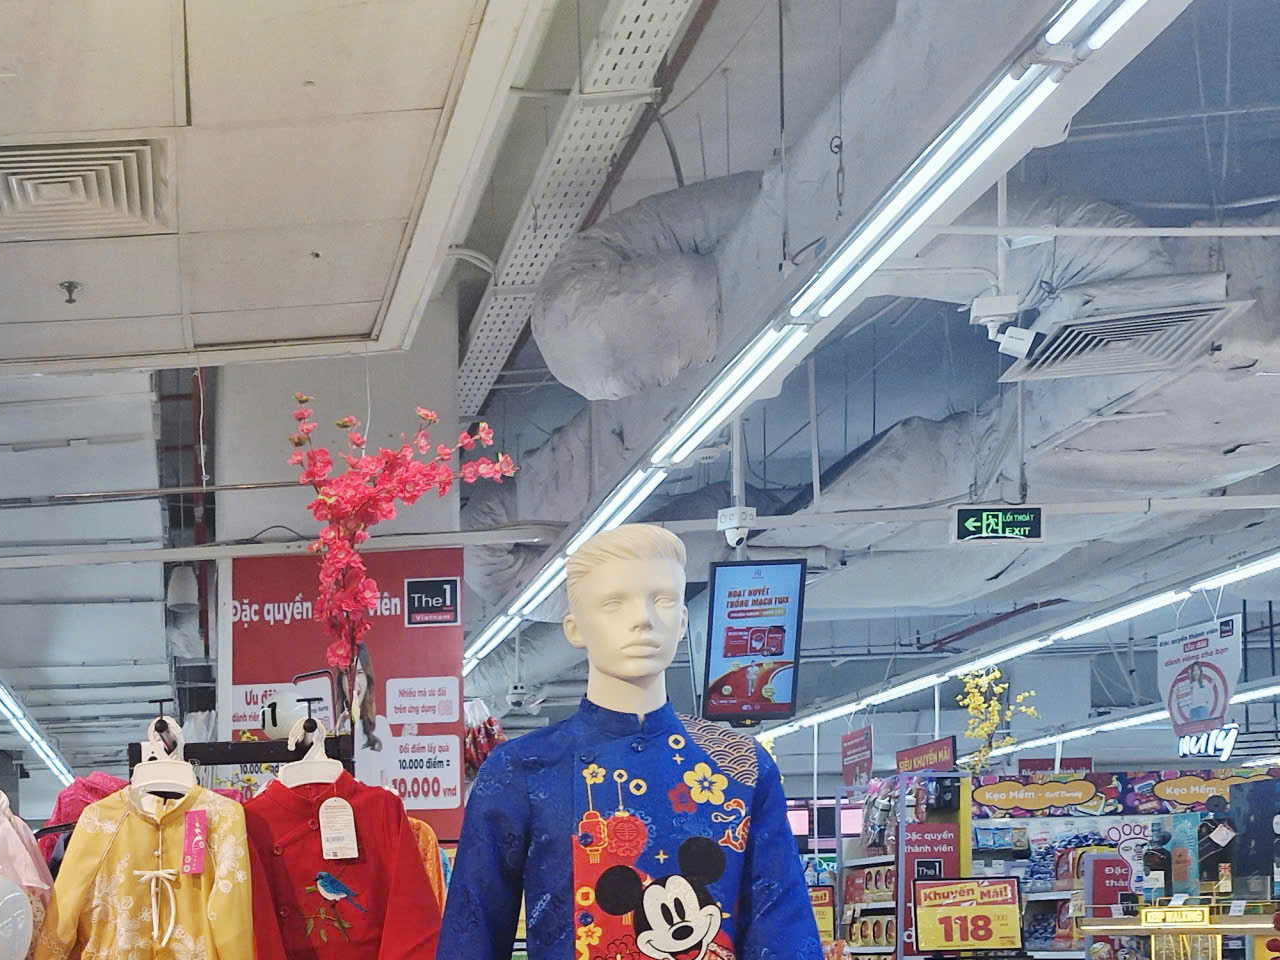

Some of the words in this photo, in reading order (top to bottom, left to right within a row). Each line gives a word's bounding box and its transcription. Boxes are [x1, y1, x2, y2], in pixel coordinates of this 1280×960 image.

[1006, 527, 1031, 535] EXIT
[232, 599, 260, 628] Đặc
[263, 593, 313, 625] quyền
[245, 689, 259, 706] Ưu
[248, 712, 260, 723] riên
[398, 758, 424, 770] 10.000
[425, 756, 444, 769] điểm
[392, 776, 440, 798] 10.000
[924, 830, 954, 841] quyền
[933, 843, 954, 852] viên
[923, 884, 975, 902] Khuyến
[979, 885, 1009, 901] Mãi!
[937, 914, 993, 943] 118
